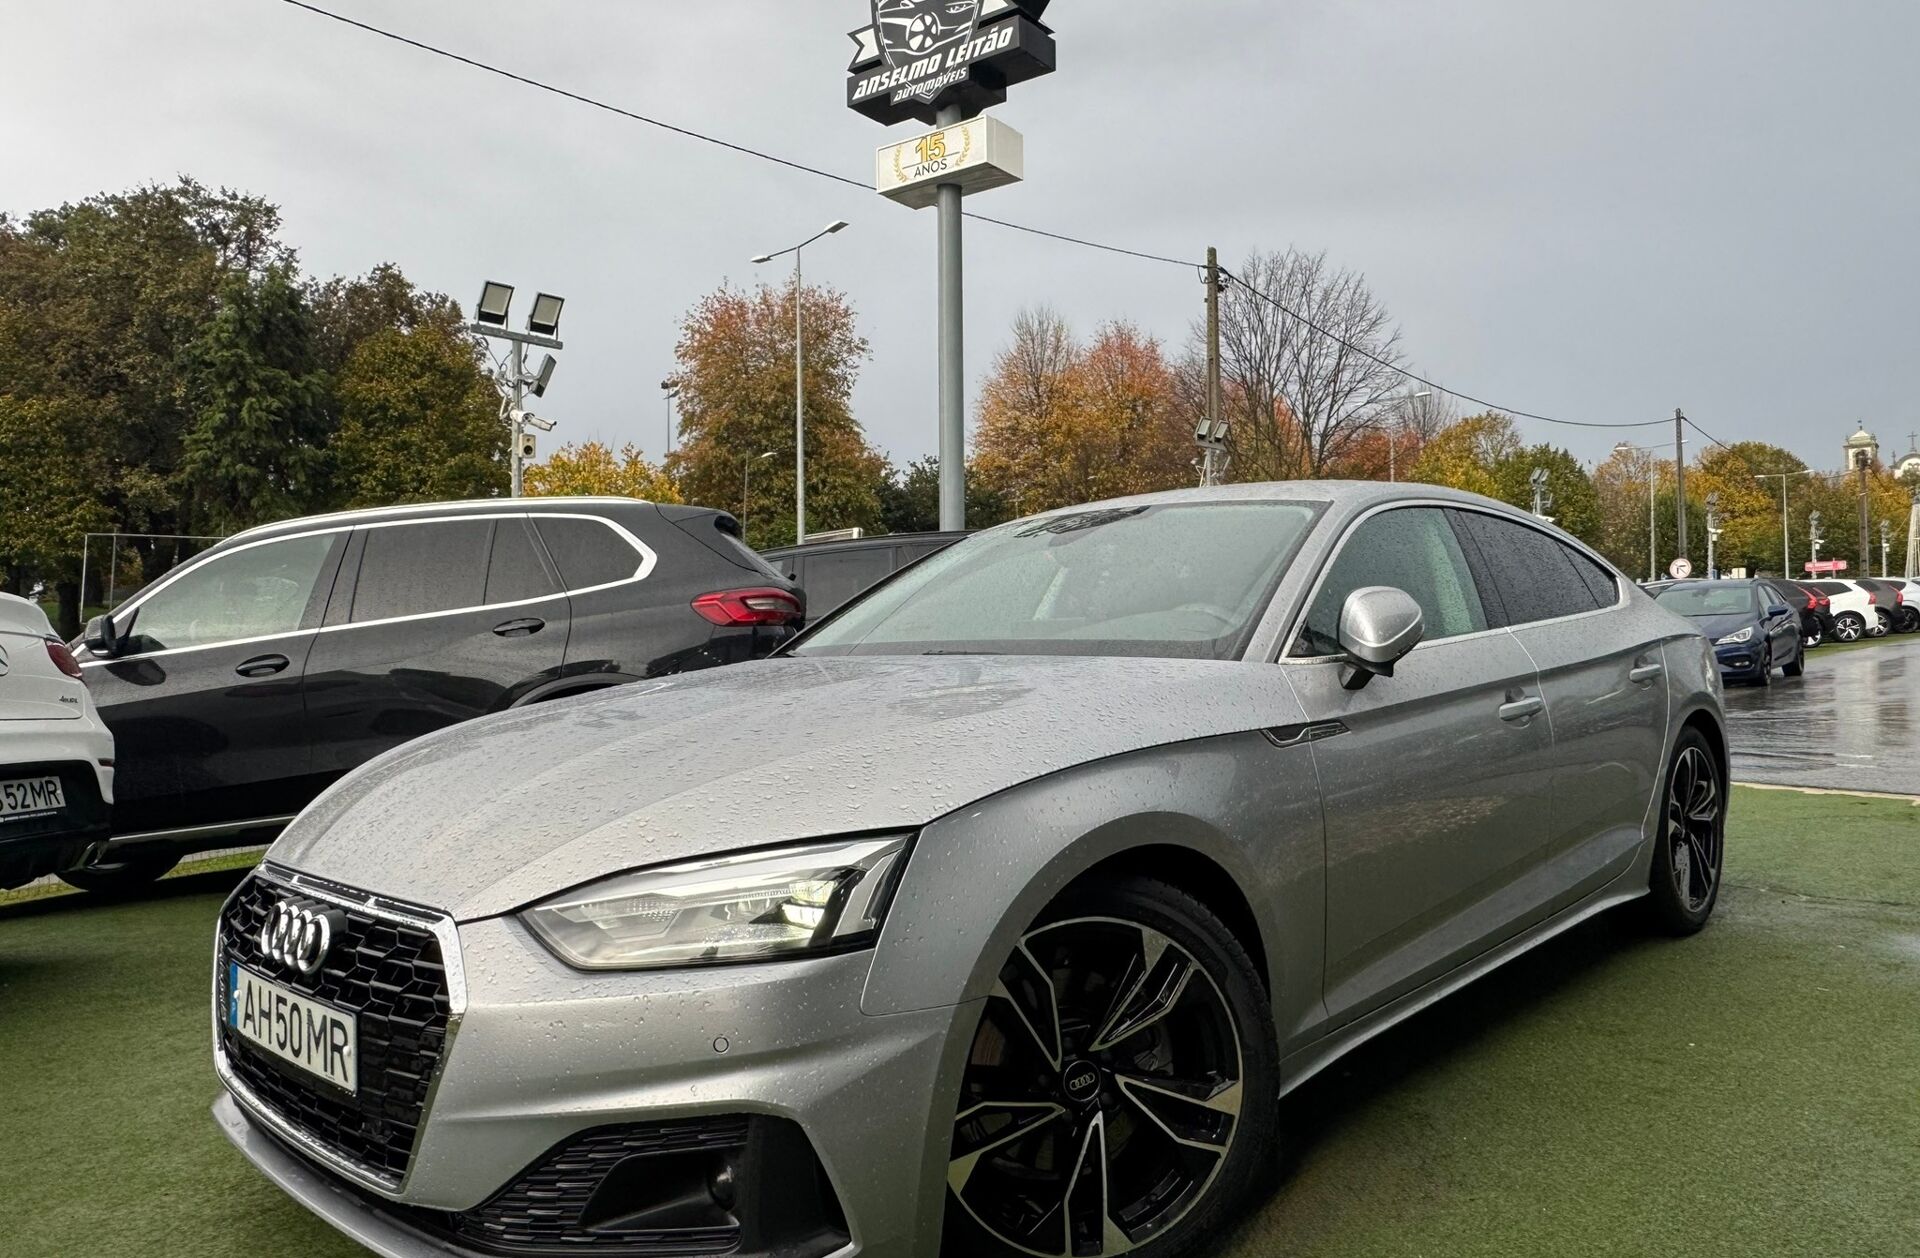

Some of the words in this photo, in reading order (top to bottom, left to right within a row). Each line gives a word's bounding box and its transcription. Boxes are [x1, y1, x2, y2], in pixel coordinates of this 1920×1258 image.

[852, 53, 942, 100] ANSELMO
[945, 26, 1013, 68] LEITÃO
[914, 158, 947, 178] ANOS
[915, 132, 946, 163] 15
[243, 979, 349, 1082] AH50MR
